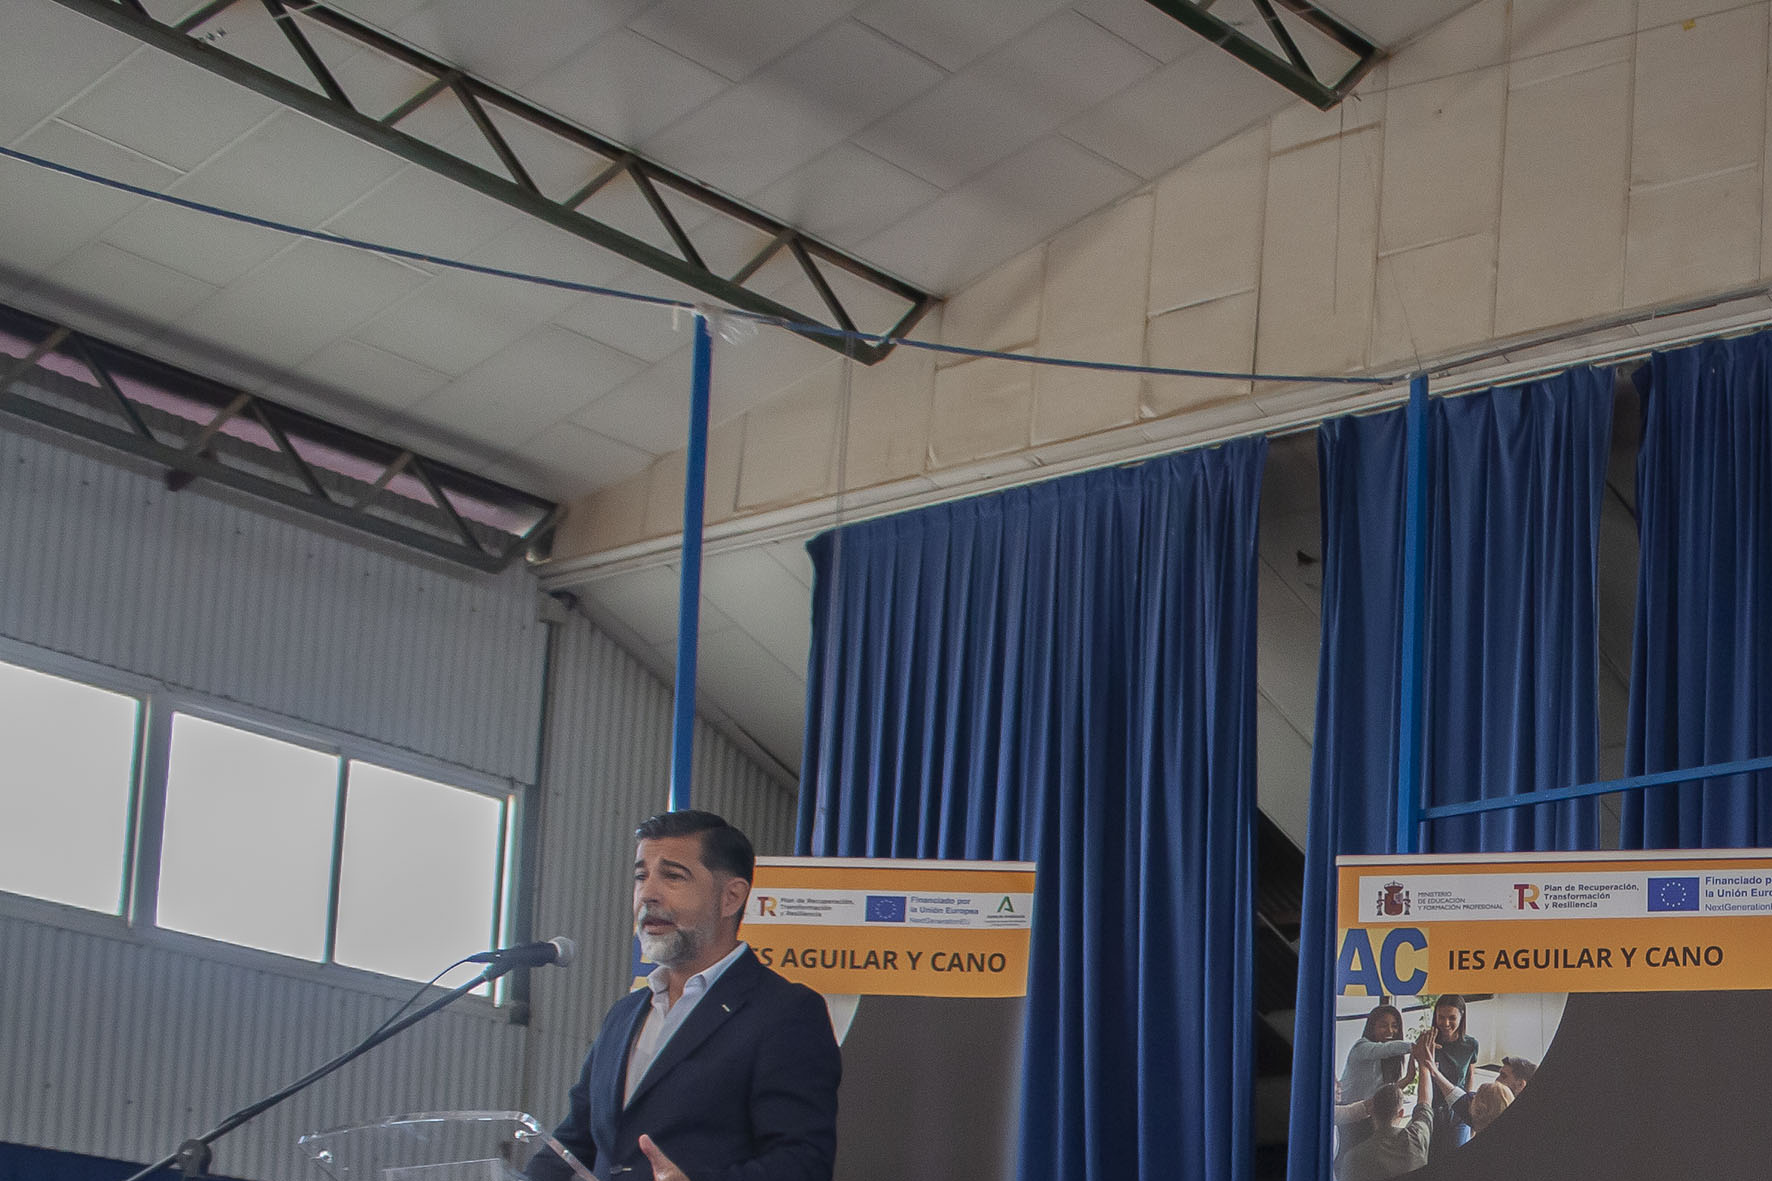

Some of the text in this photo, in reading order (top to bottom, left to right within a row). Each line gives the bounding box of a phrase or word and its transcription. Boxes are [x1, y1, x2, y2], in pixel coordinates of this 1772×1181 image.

[1704, 875, 1763, 886] Financiado
[1543, 883, 1640, 894] Plan de Recuperación,
[1704, 888, 1715, 898] la
[1717, 886, 1748, 898] Unión
[910, 896, 971, 907] Financiado por
[1427, 896, 1466, 904] EDUCACIÓN
[1543, 892, 1611, 901] Transformación
[919, 906, 943, 915] Unión
[1551, 901, 1598, 909] Resiliencia
[780, 948, 899, 970] AGUILAR
[905, 950, 924, 971] Y
[930, 952, 1007, 974] CANO
[1337, 927, 1429, 997] AC
[1448, 945, 1724, 972] IES AGUILAR Y CANO
